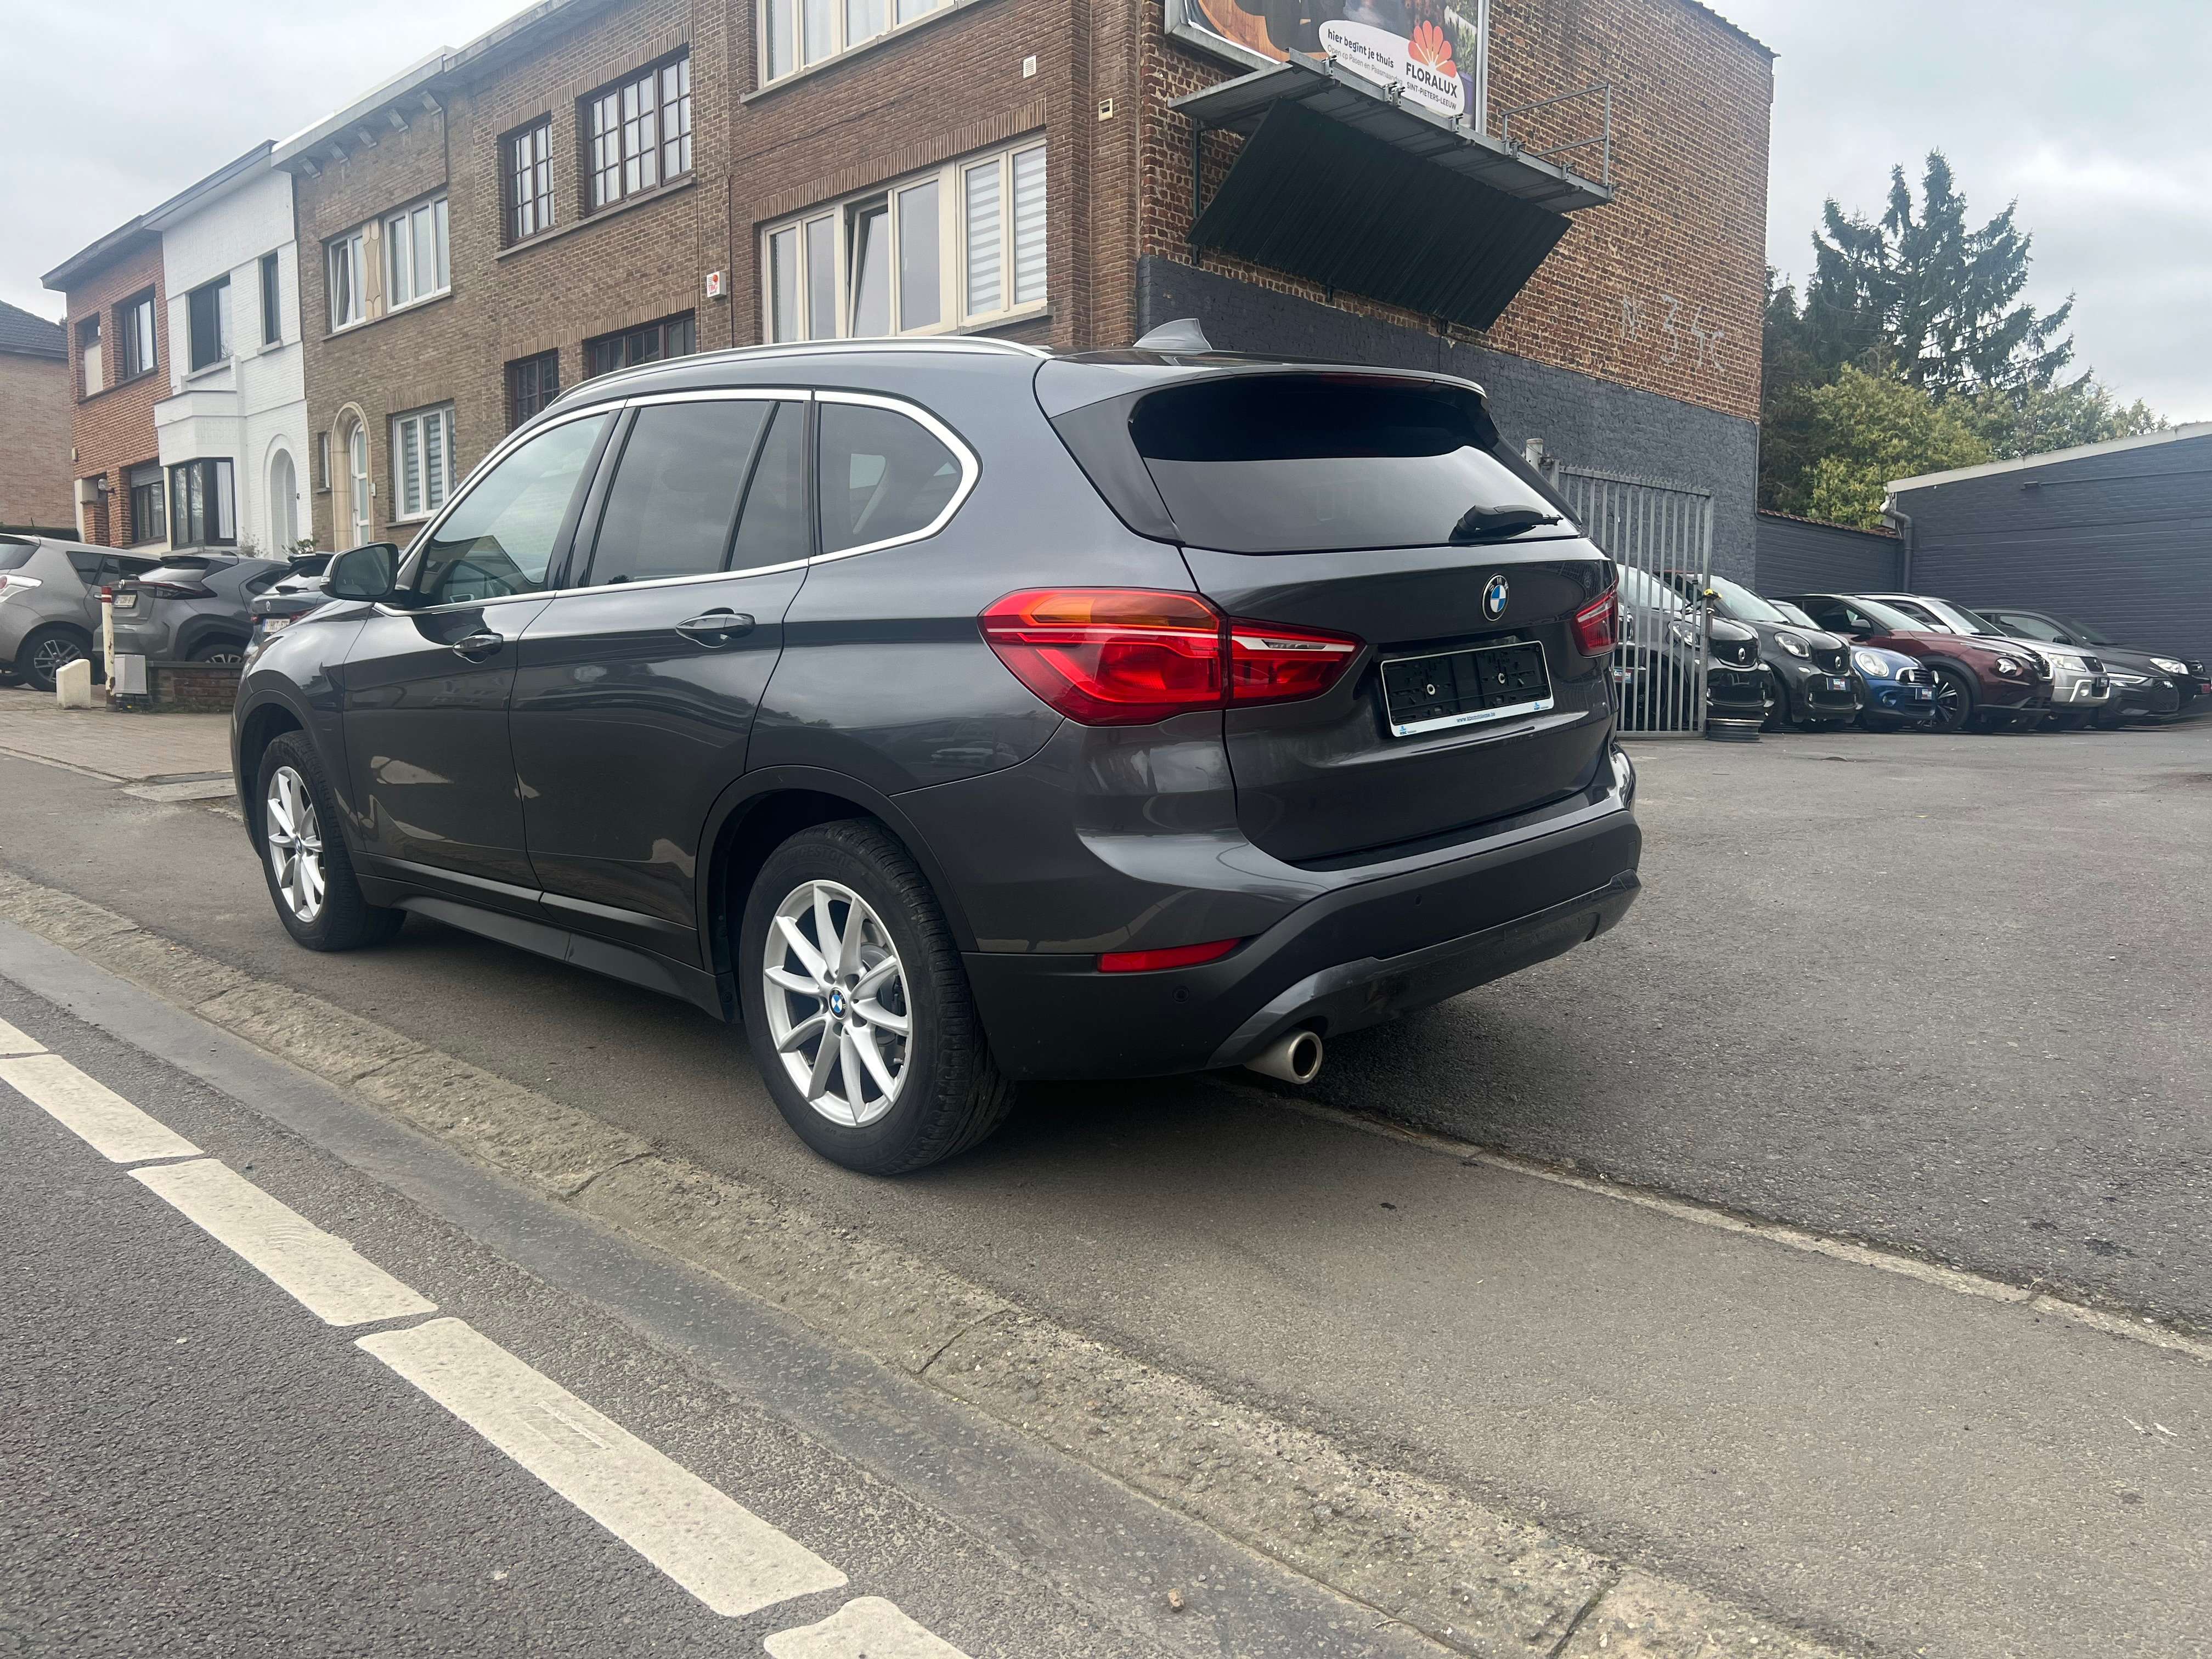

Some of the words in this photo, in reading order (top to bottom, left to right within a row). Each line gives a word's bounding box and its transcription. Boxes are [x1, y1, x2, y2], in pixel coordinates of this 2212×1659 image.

[1328, 29, 1342, 44] hier
[1344, 36, 1367, 55] begint
[1368, 48, 1374, 59] je
[1376, 52, 1394, 69] thuis
[1328, 44, 1341, 57] Open
[1349, 54, 1363, 67] Pasen
[1406, 62, 1457, 98] FLORALUX
[1406, 82, 1457, 110] SINT-PIETERS-LEEUW
